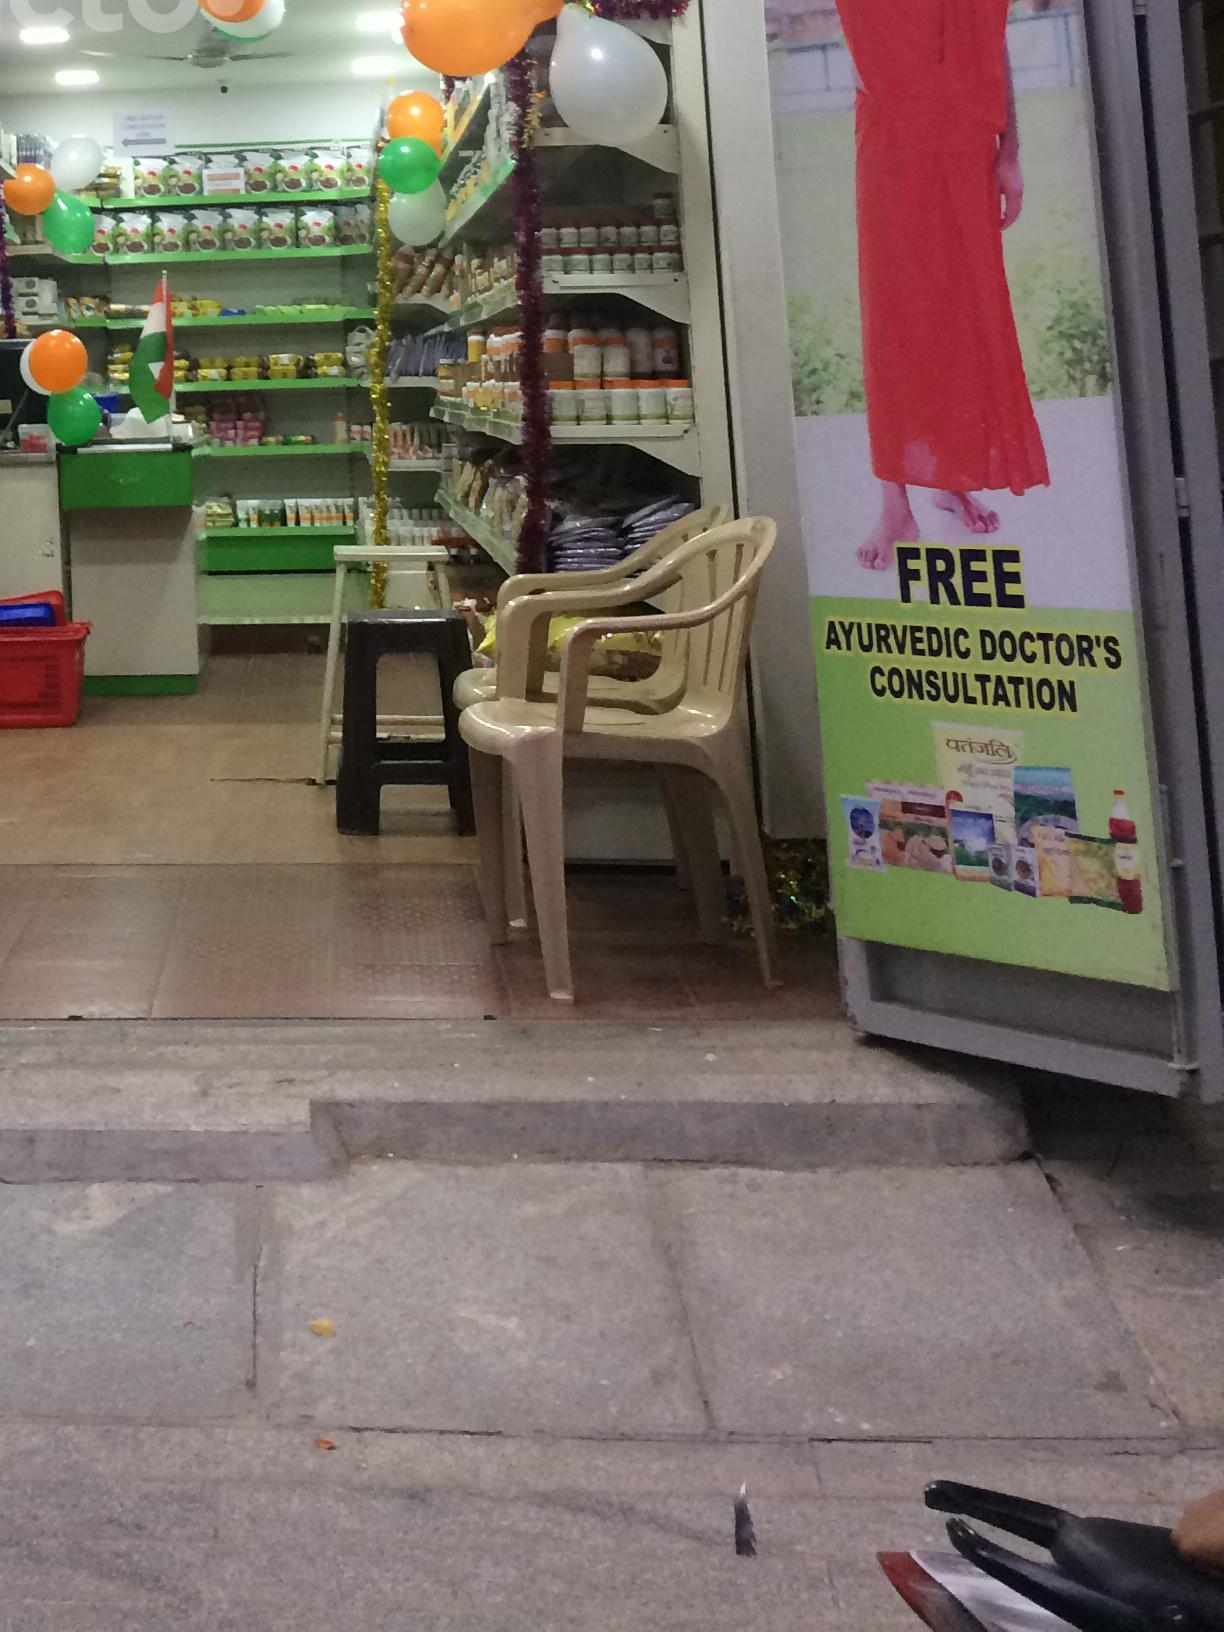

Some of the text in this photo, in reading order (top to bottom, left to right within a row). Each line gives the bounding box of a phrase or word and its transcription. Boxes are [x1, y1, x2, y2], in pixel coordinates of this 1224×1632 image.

[896, 546, 1026, 609] FREE
[825, 620, 1123, 670] AYURVEDIC DOCTOR'S
[869, 665, 1078, 713] CONSULTATION
[946, 737, 1013, 759] पतंजलि
